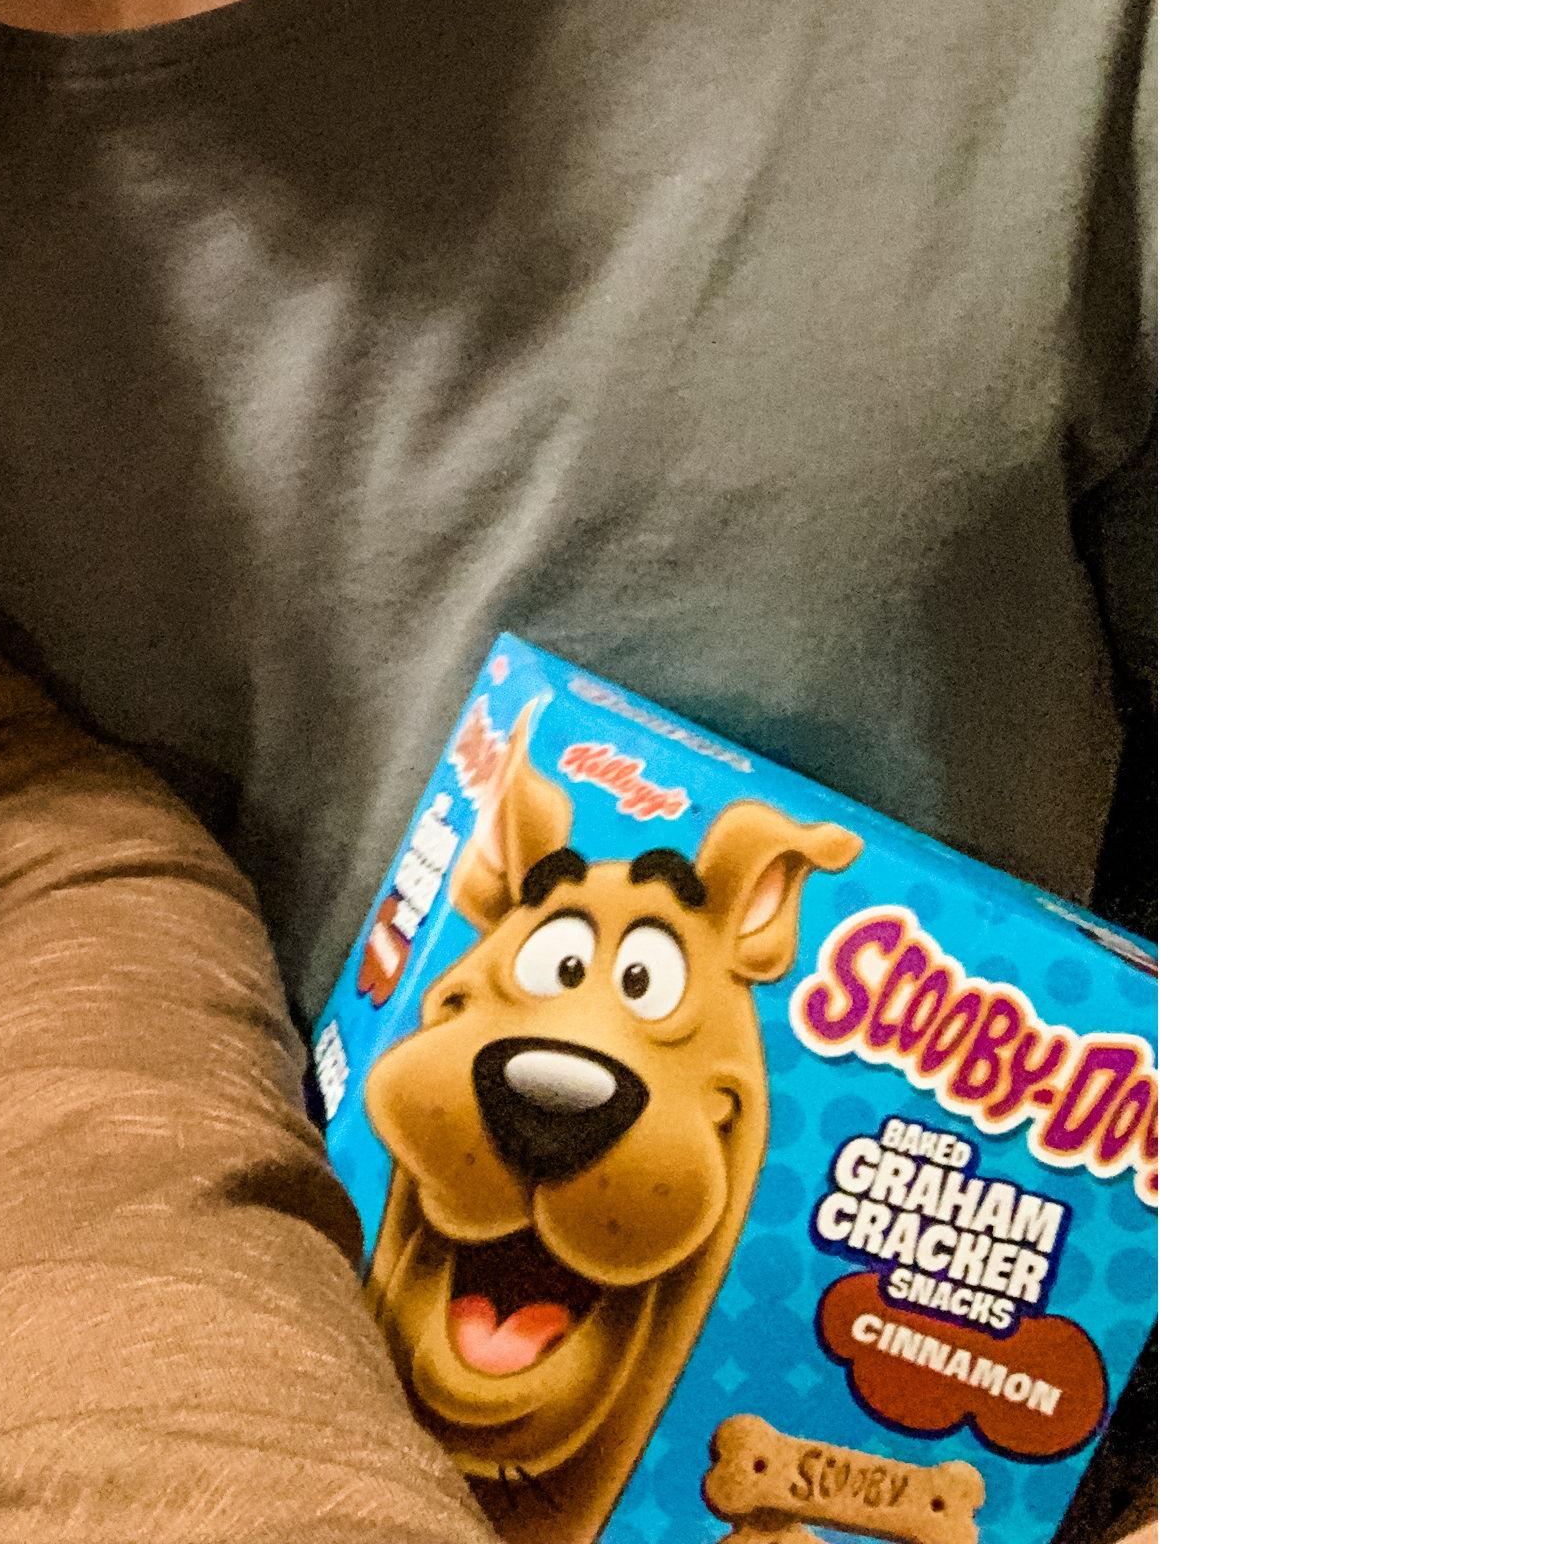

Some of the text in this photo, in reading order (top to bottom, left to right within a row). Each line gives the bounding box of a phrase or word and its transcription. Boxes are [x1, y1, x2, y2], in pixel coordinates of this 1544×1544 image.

[881, 1118, 972, 1168] BAKED
[835, 1137, 1064, 1254] GRAHAM
[816, 1191, 1050, 1304] CRACKER
[887, 1268, 1016, 1330] SNACKS
[850, 1313, 1063, 1416] CINNAMON
[788, 1447, 909, 1508] SCOOBY
